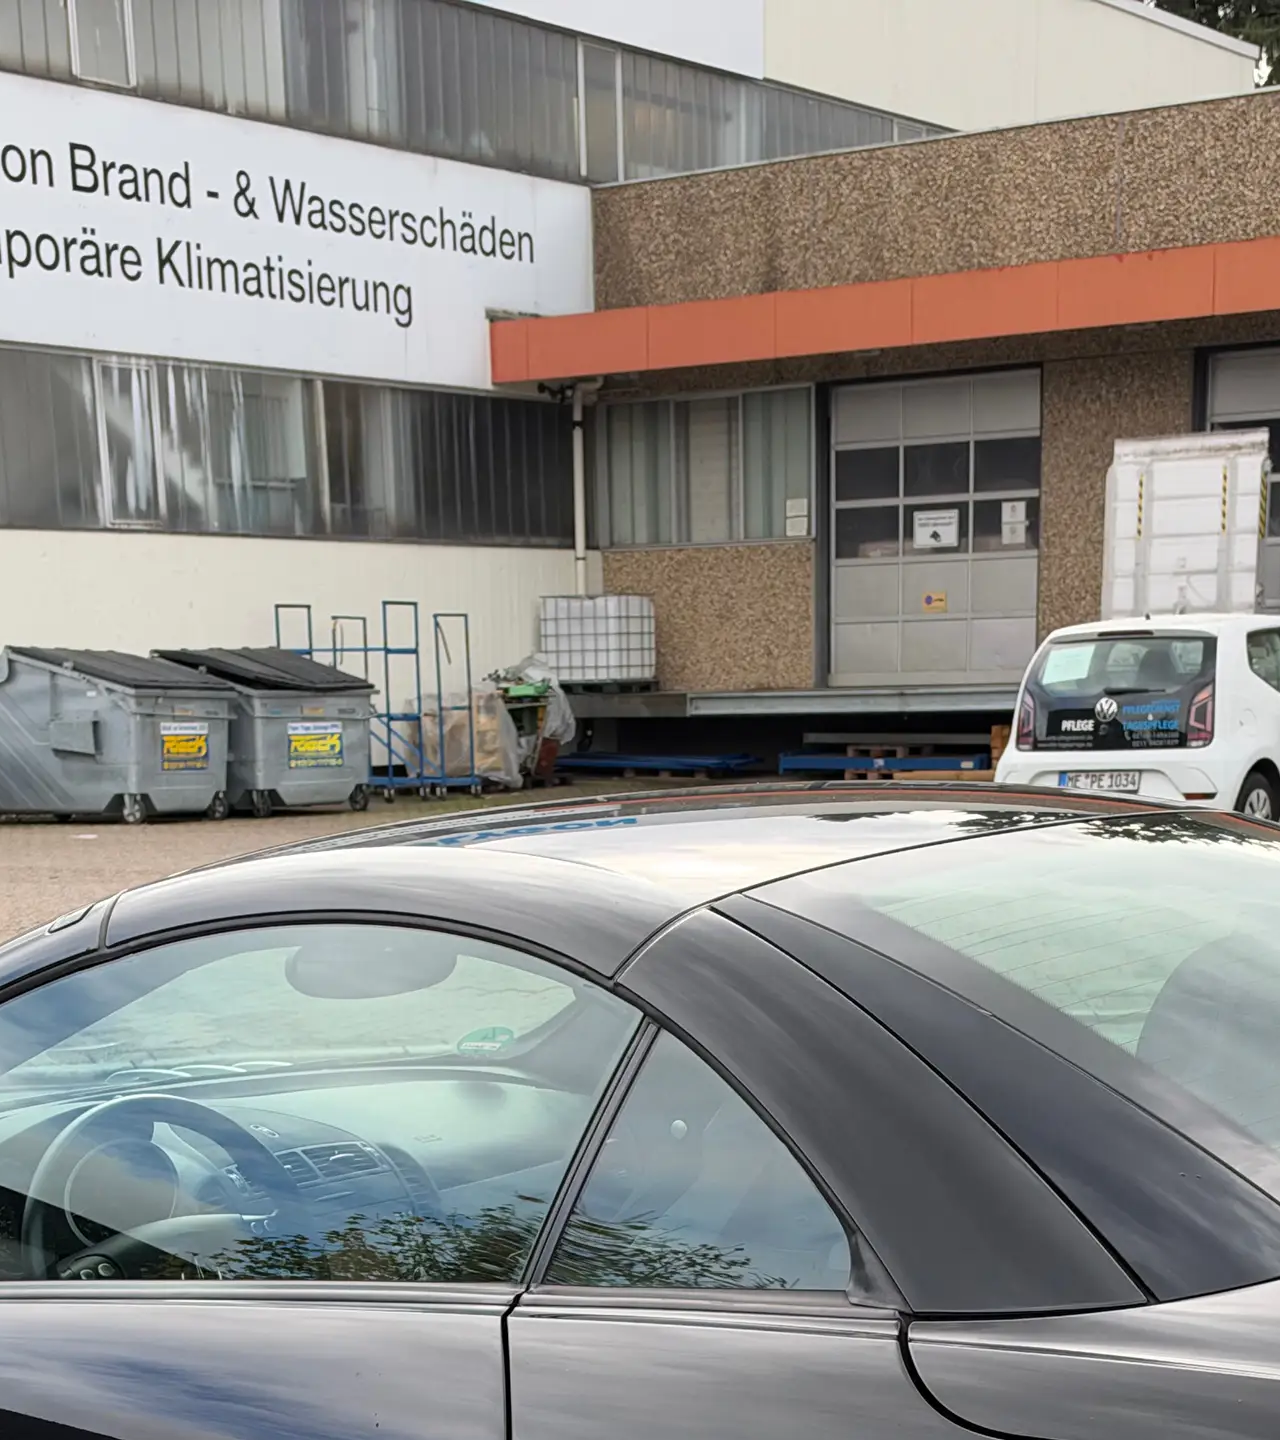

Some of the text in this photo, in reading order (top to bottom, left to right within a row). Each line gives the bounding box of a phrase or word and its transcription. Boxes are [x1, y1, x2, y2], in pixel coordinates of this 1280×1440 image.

[68, 141, 191, 209] Brand
[233, 169, 260, 220] &
[268, 175, 535, 264] Wasserschäden
[156, 236, 414, 329] Klimatisierung
[1061, 719, 1096, 732] PFLEGE
[1090, 773, 1106, 791] PE
[1107, 773, 1137, 791] 1034
